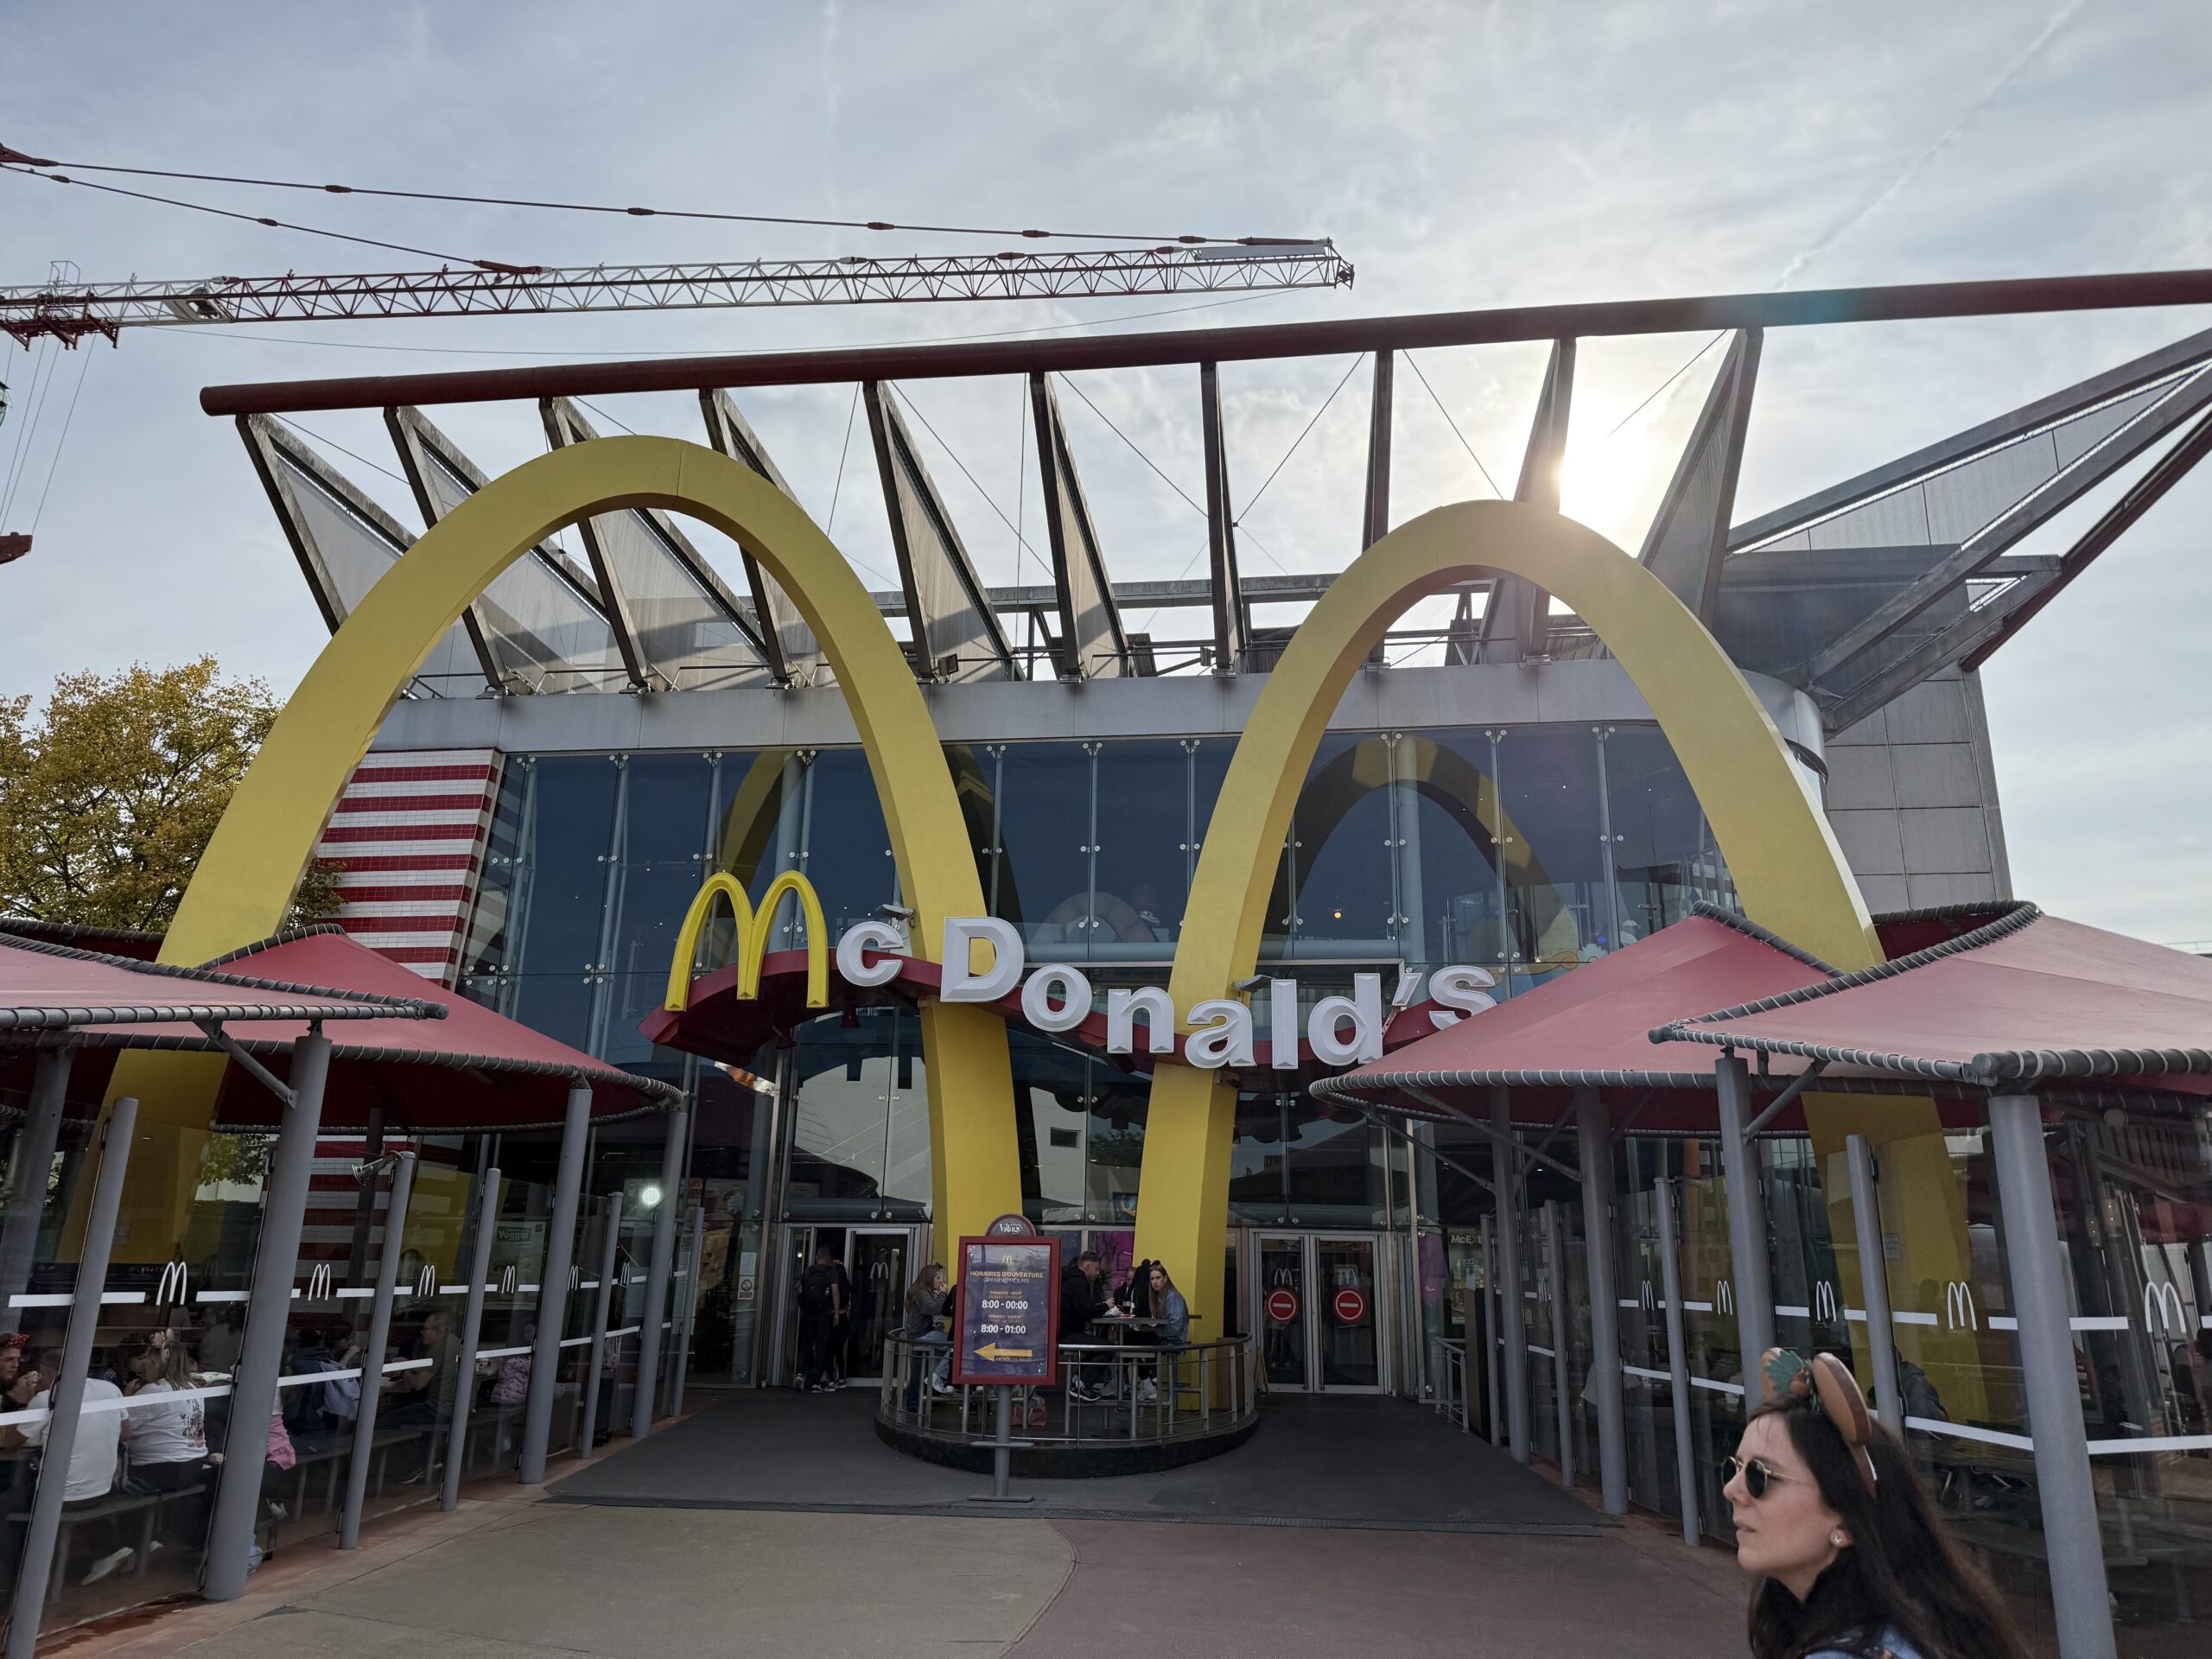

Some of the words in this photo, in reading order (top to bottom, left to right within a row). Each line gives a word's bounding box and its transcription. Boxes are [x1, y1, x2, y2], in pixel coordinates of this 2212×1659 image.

[982, 1300, 1000, 1309] 8:00
[1006, 1300, 1028, 1310] 00:00
[981, 1324, 999, 1333] 8:00
[1005, 1325, 1027, 1334] 01:00
